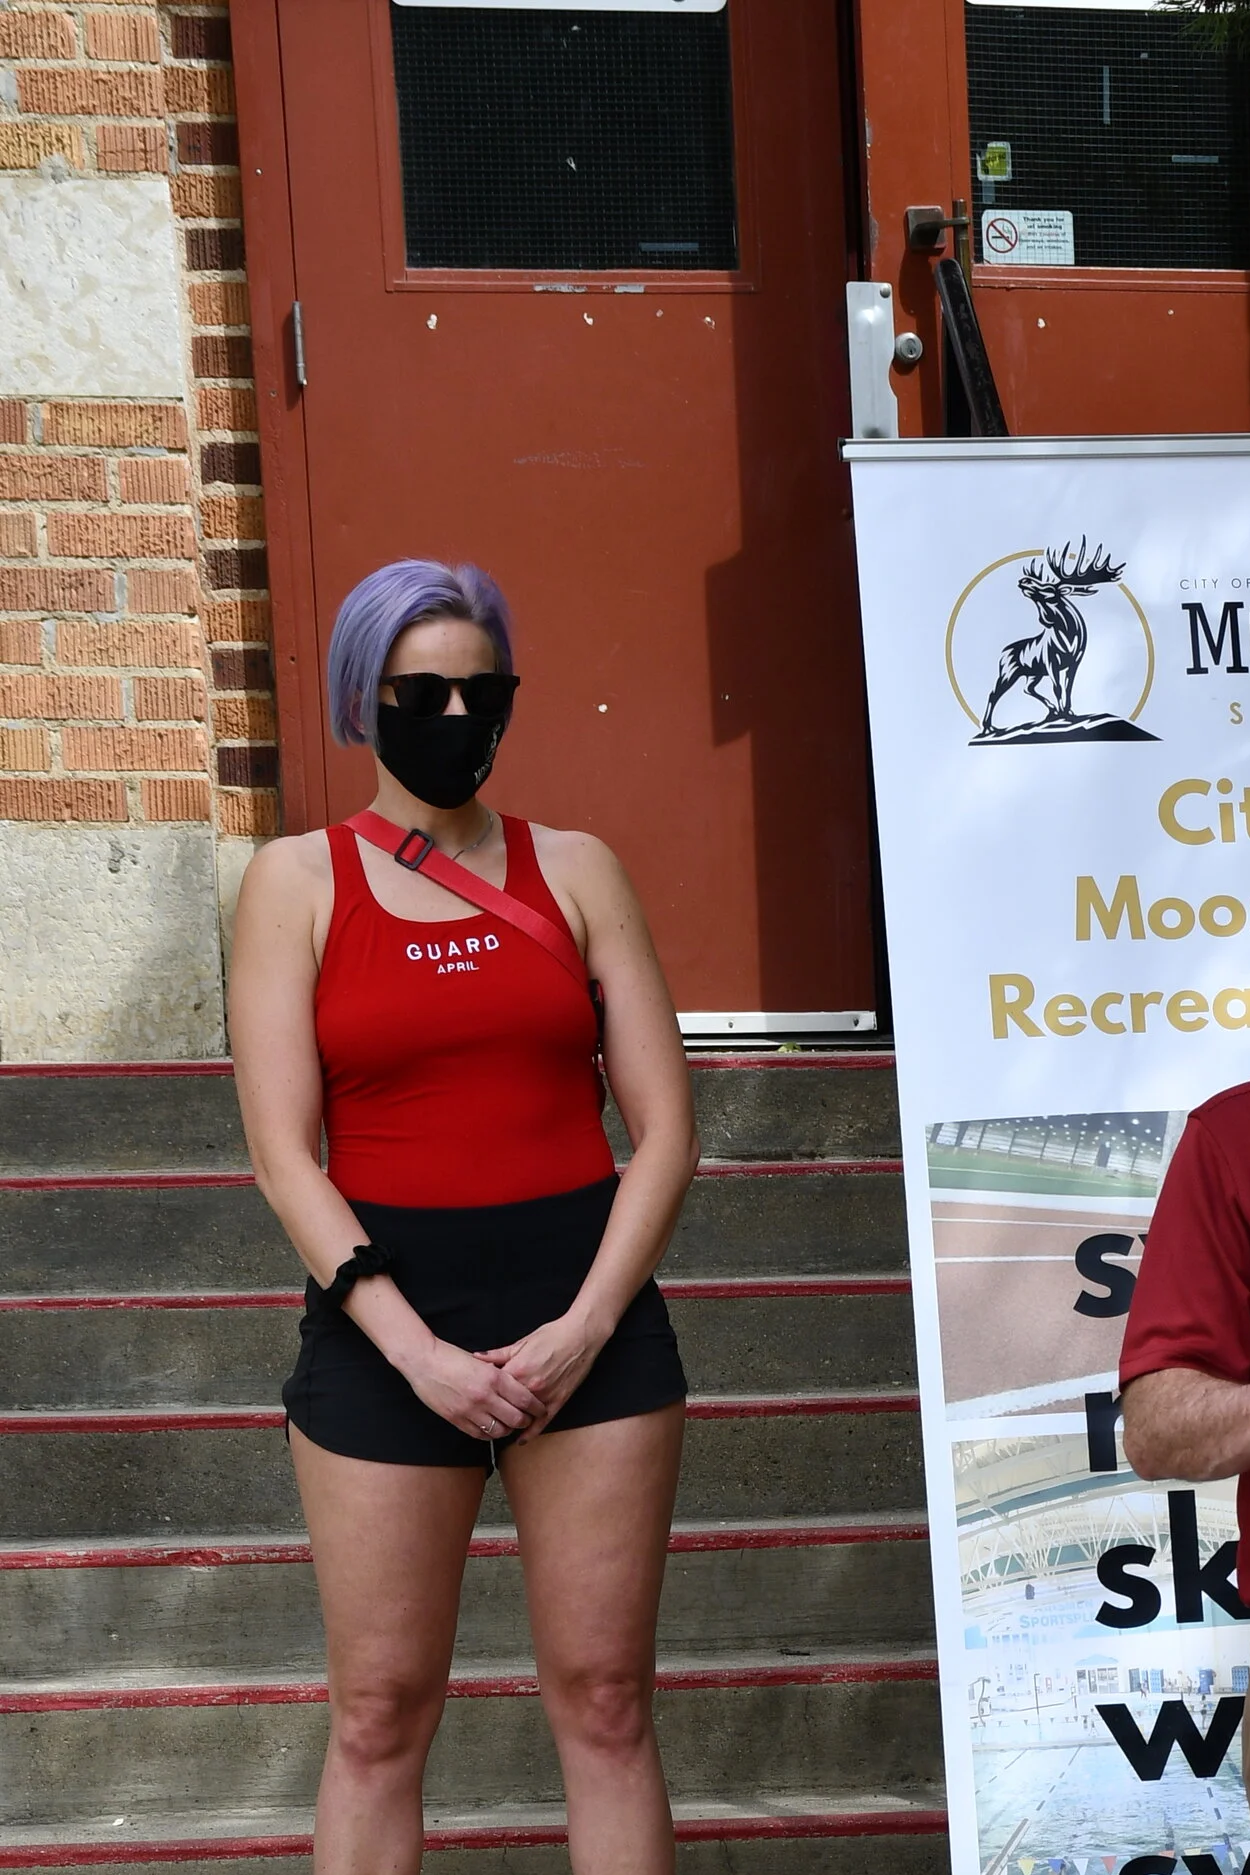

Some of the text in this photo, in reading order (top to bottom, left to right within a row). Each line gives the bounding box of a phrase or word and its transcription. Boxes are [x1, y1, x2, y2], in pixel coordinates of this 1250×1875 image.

[1179, 577, 1219, 591] CITY
[406, 934, 499, 960] GUARD
[437, 960, 479, 974] APRIL
